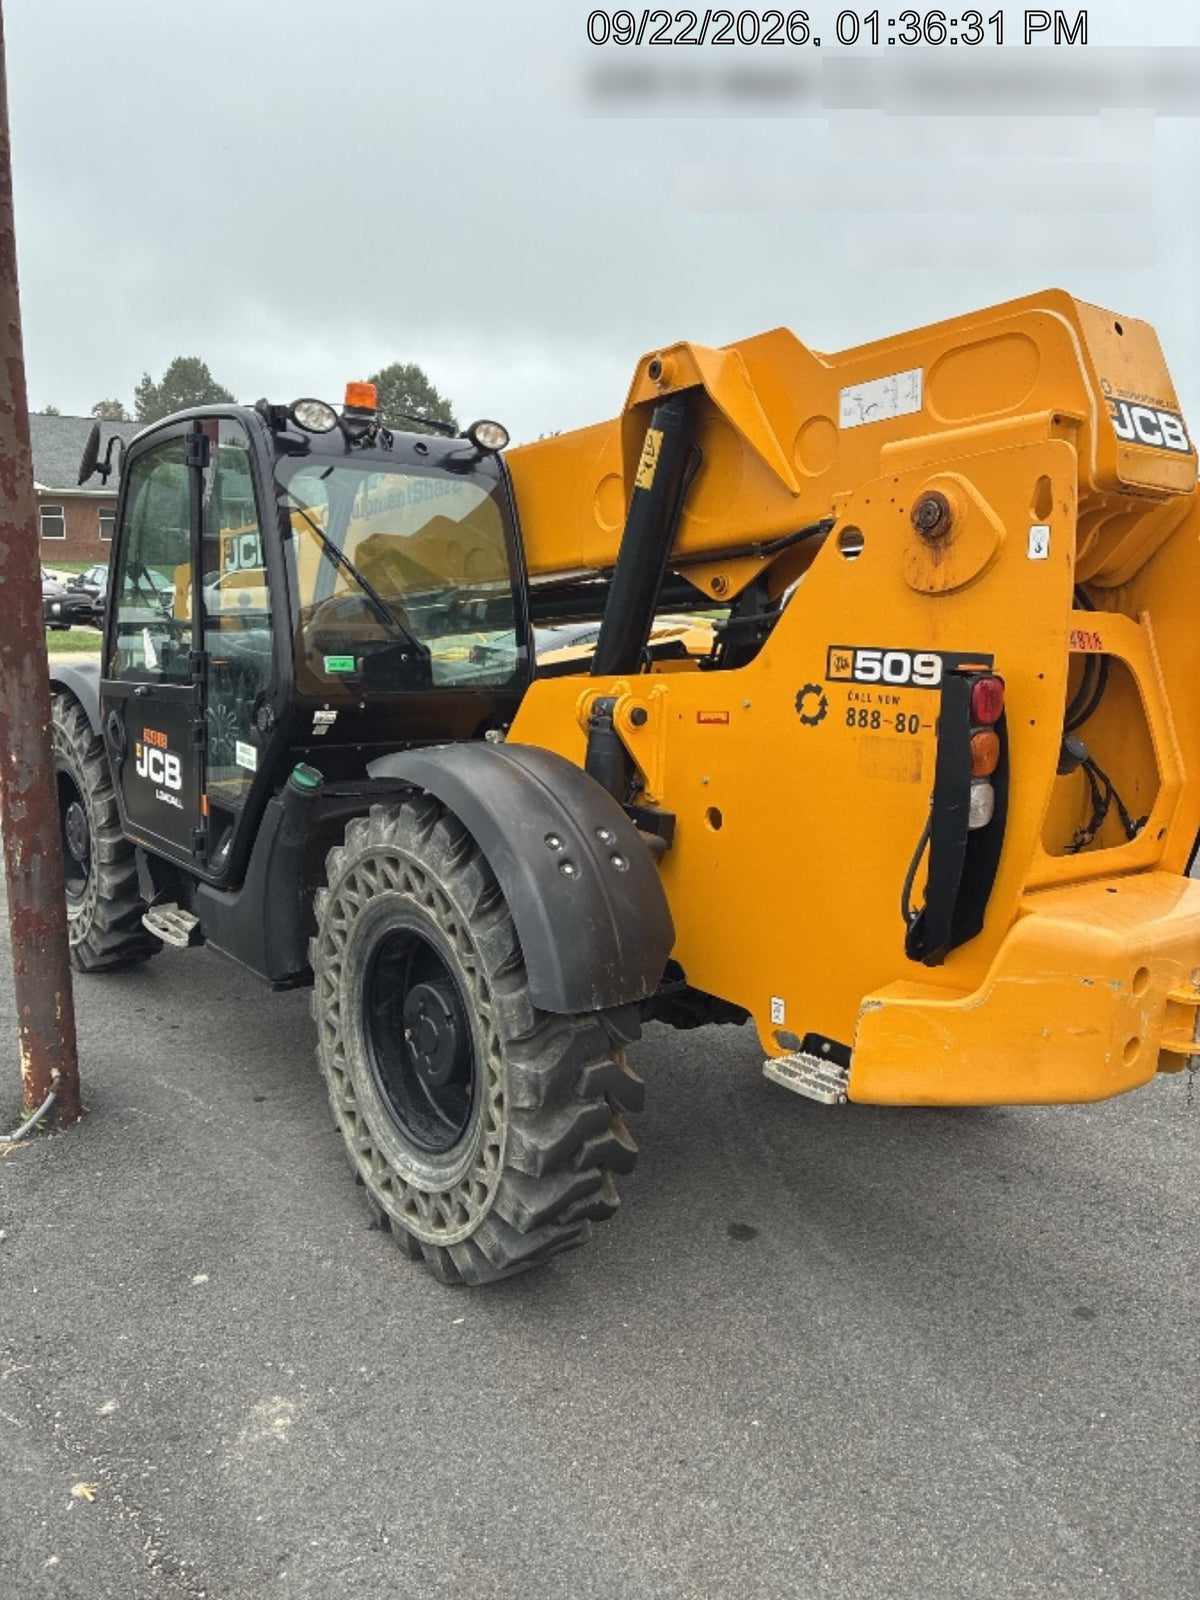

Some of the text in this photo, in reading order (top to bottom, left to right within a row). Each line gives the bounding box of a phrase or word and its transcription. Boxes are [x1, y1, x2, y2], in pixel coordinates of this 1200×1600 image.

[1112, 402, 1189, 451] JCB
[854, 649, 943, 685] 509
[847, 690, 901, 706] CALL NOW
[846, 707, 939, 737] 888-80-
[136, 745, 182, 790] JCB
